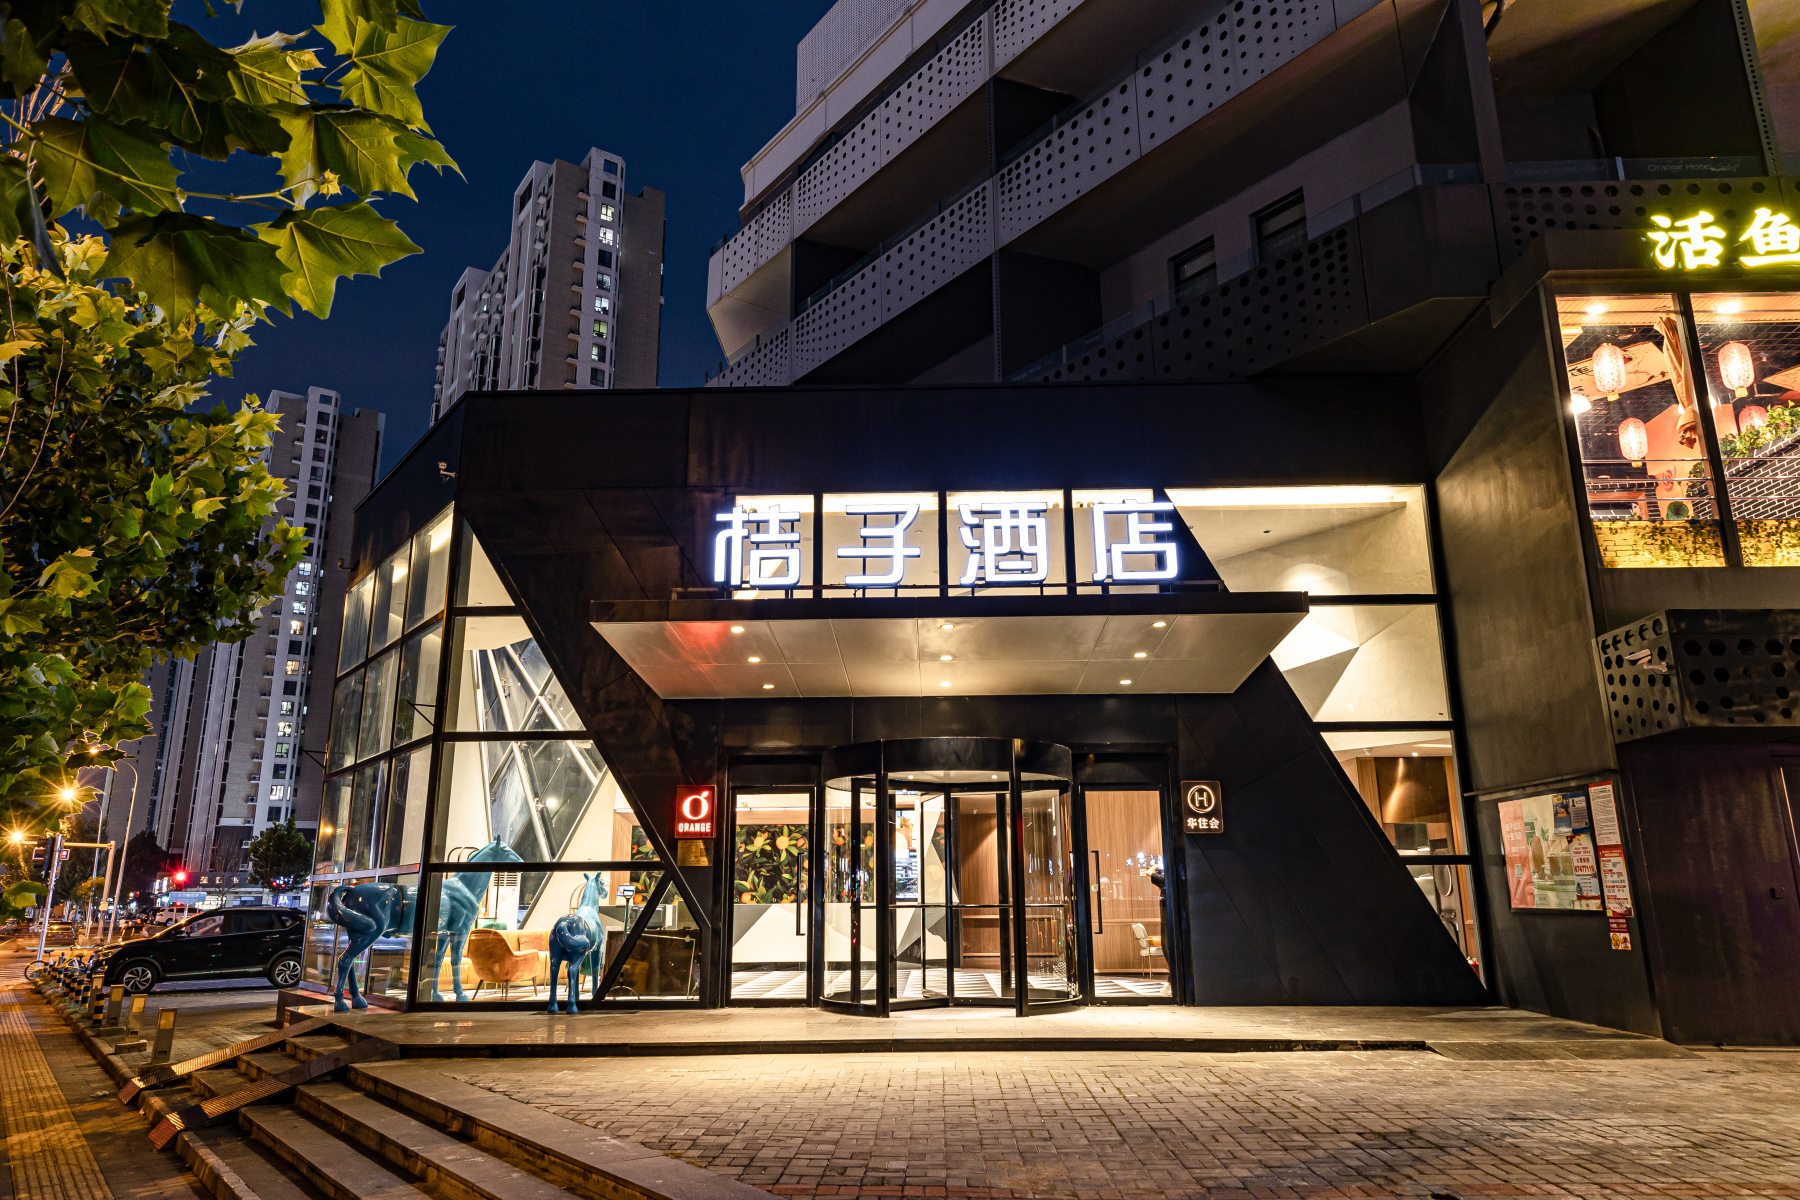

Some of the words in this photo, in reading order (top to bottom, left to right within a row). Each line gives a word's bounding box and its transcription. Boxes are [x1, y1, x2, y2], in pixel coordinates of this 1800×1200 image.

[1648, 163, 1684, 173] Orange
[714, 499, 1179, 587] 桔子酒店
[678, 822, 711, 833] ORANGE
[1187, 817, 1220, 830] 华住会
